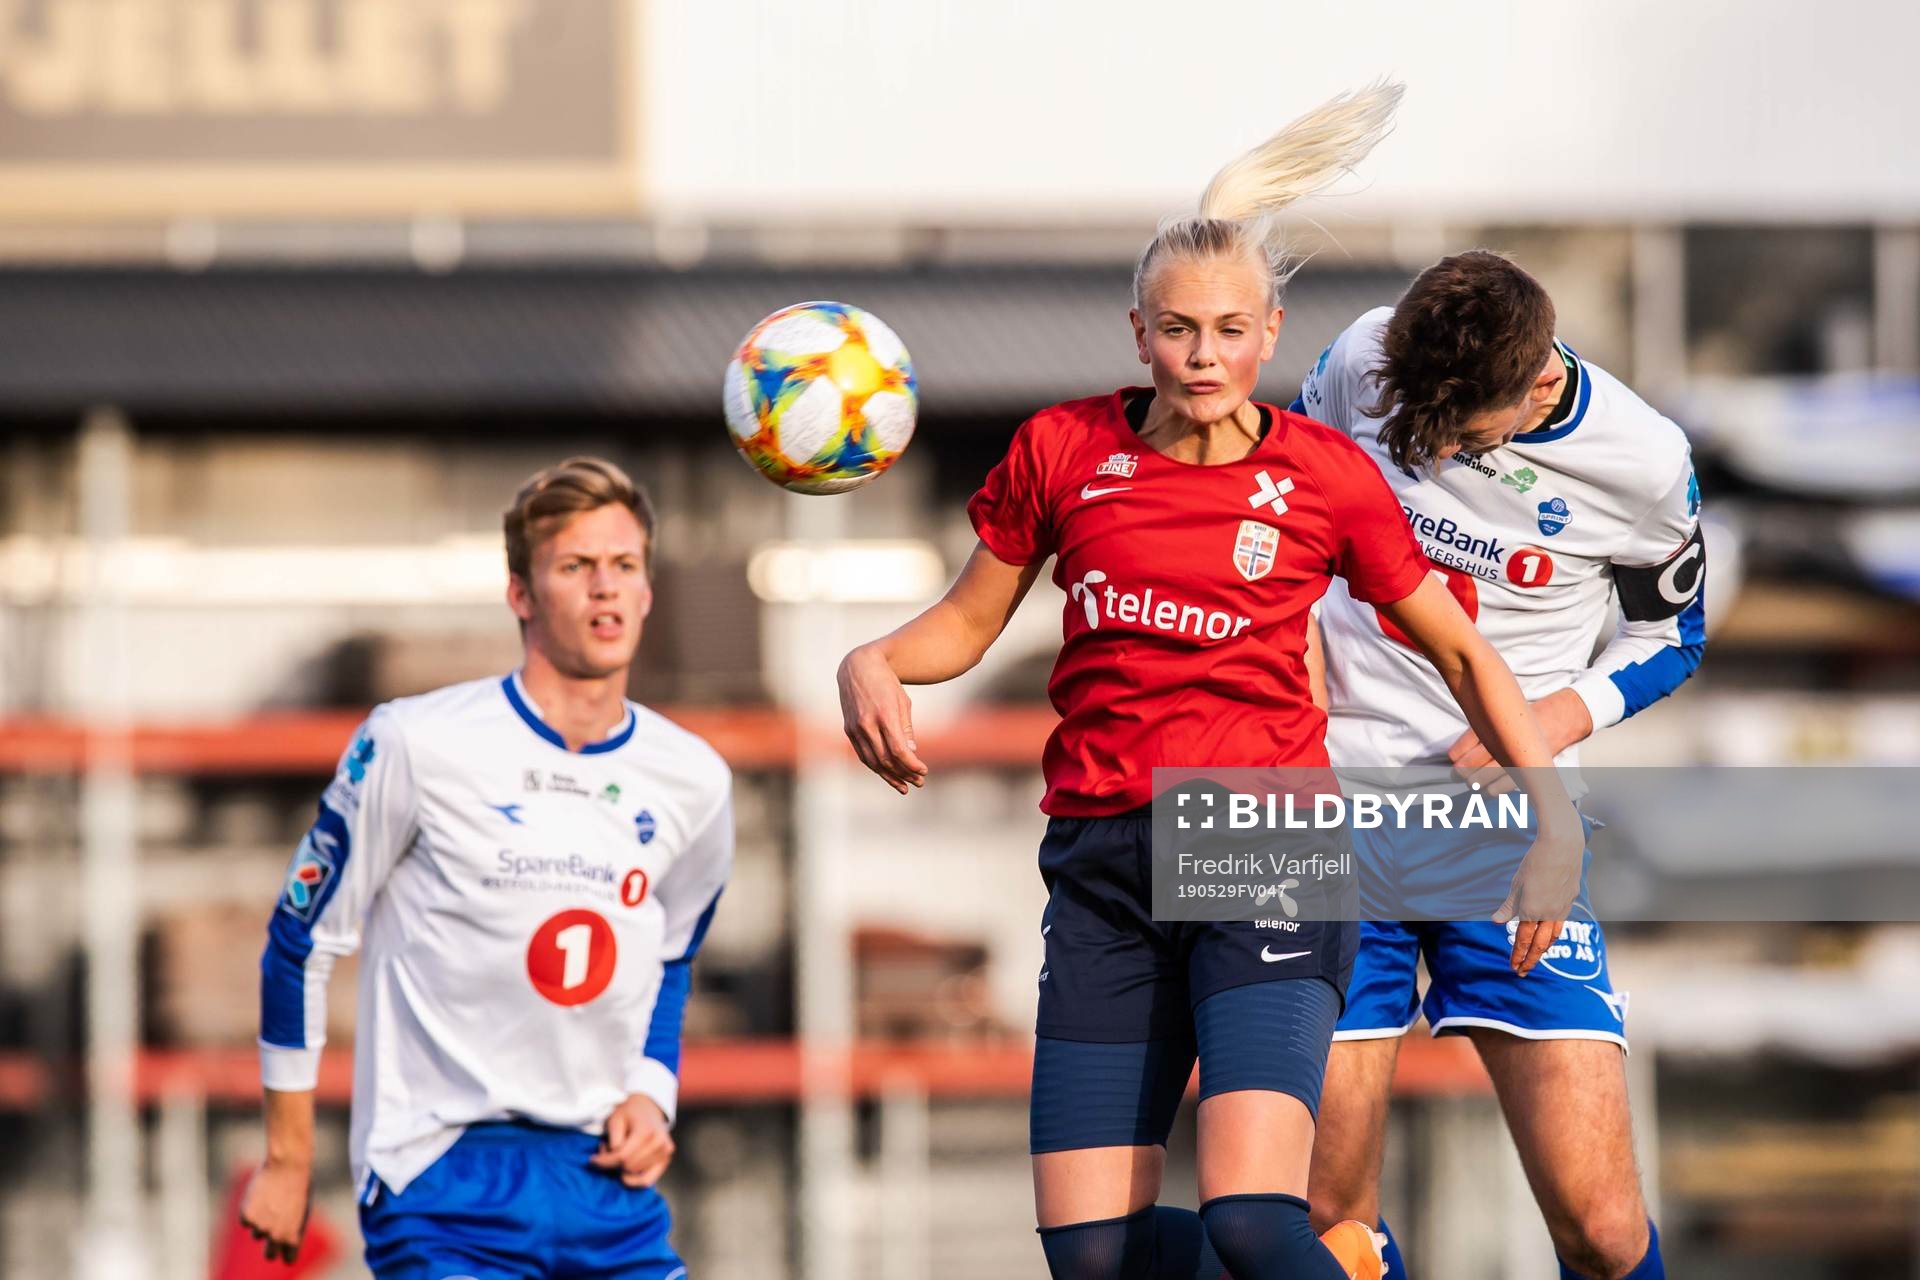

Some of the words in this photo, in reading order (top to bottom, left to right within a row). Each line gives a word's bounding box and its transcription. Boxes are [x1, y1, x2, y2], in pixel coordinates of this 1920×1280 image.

[1101, 462, 1130, 474] TINE
[1452, 452, 1497, 478] andskap
[1402, 505, 1506, 564] areBank
[1657, 542, 1704, 604] C
[1104, 585, 1252, 640] telenor
[1254, 918, 1300, 932] telenor
[555, 924, 592, 990] 1
